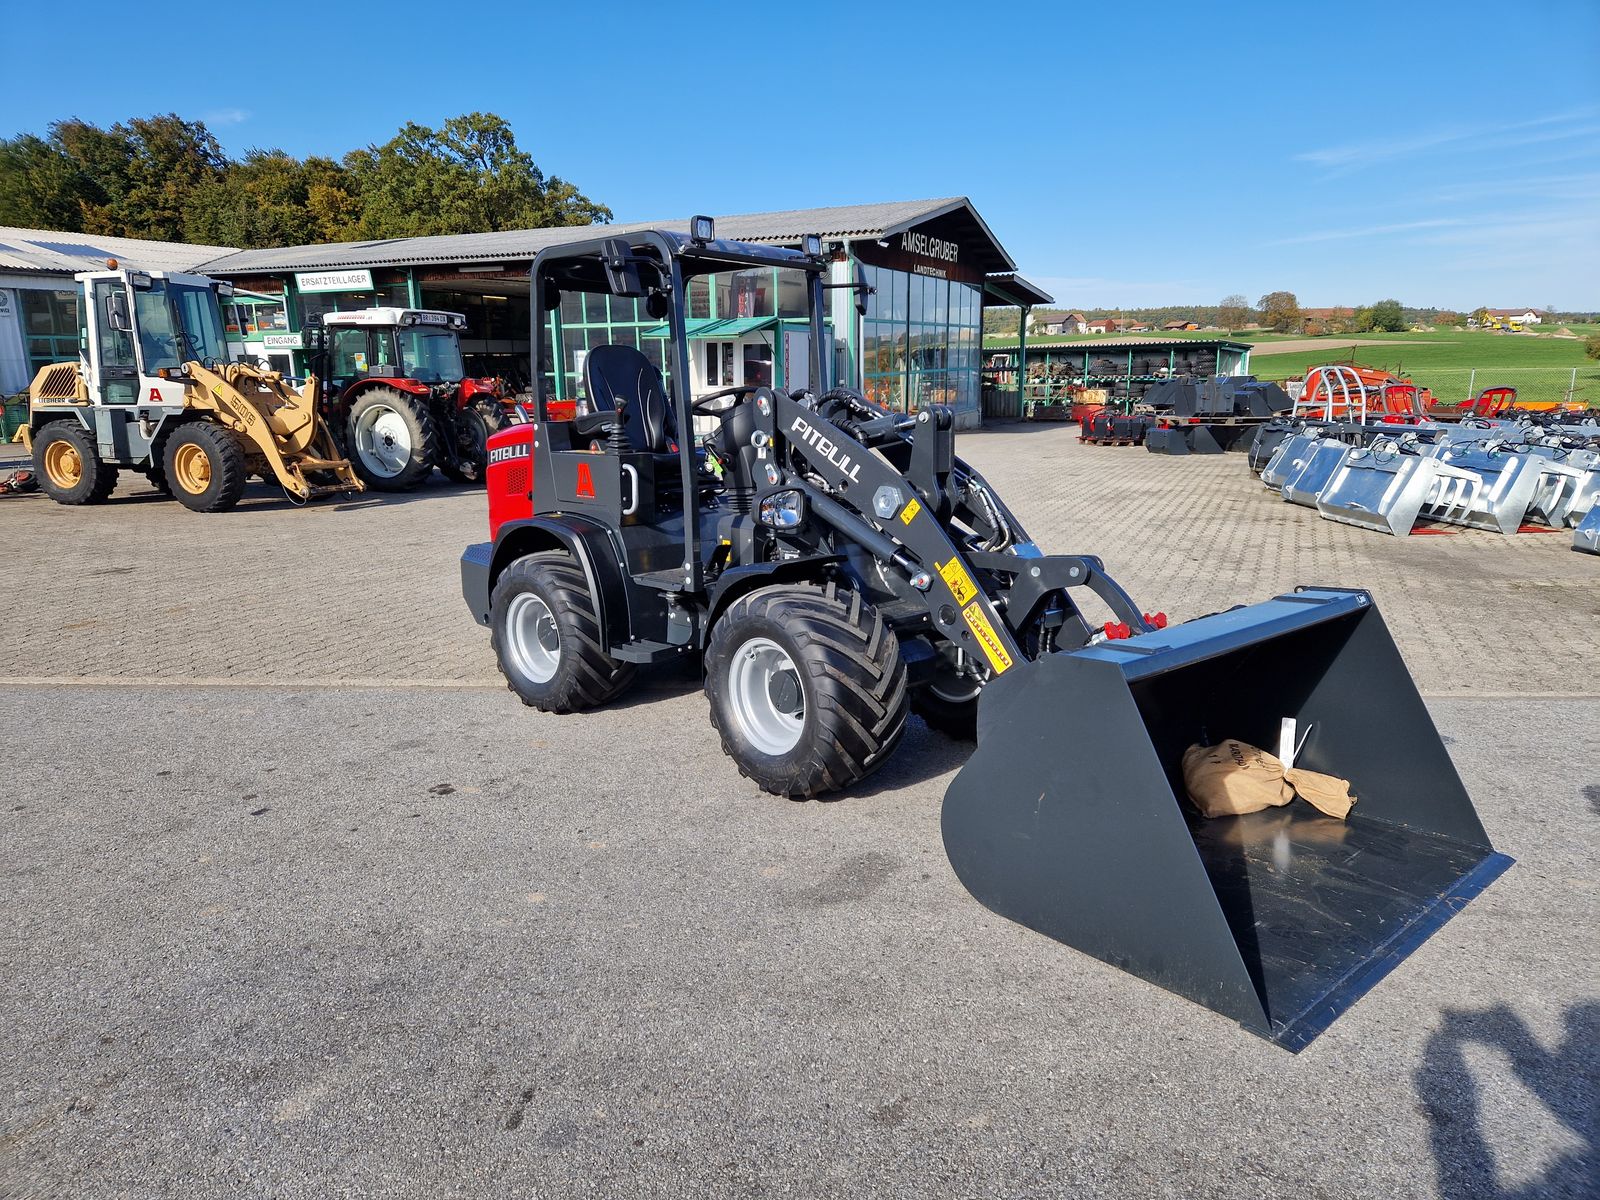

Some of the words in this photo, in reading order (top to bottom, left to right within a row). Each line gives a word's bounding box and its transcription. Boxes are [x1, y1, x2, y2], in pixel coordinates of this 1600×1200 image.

[901, 231, 959, 262] AMSELGRUBER
[301, 274, 367, 286] ERSATZTEILLAGER
[913, 264, 947, 278] LANDTECHNIK
[267, 336, 298, 345] EINGANG
[149, 388, 163, 401] A
[230, 394, 256, 426] 506
[490, 444, 529, 463] PITBULL
[791, 416, 861, 484] PITBULL
[576, 463, 595, 495] A
